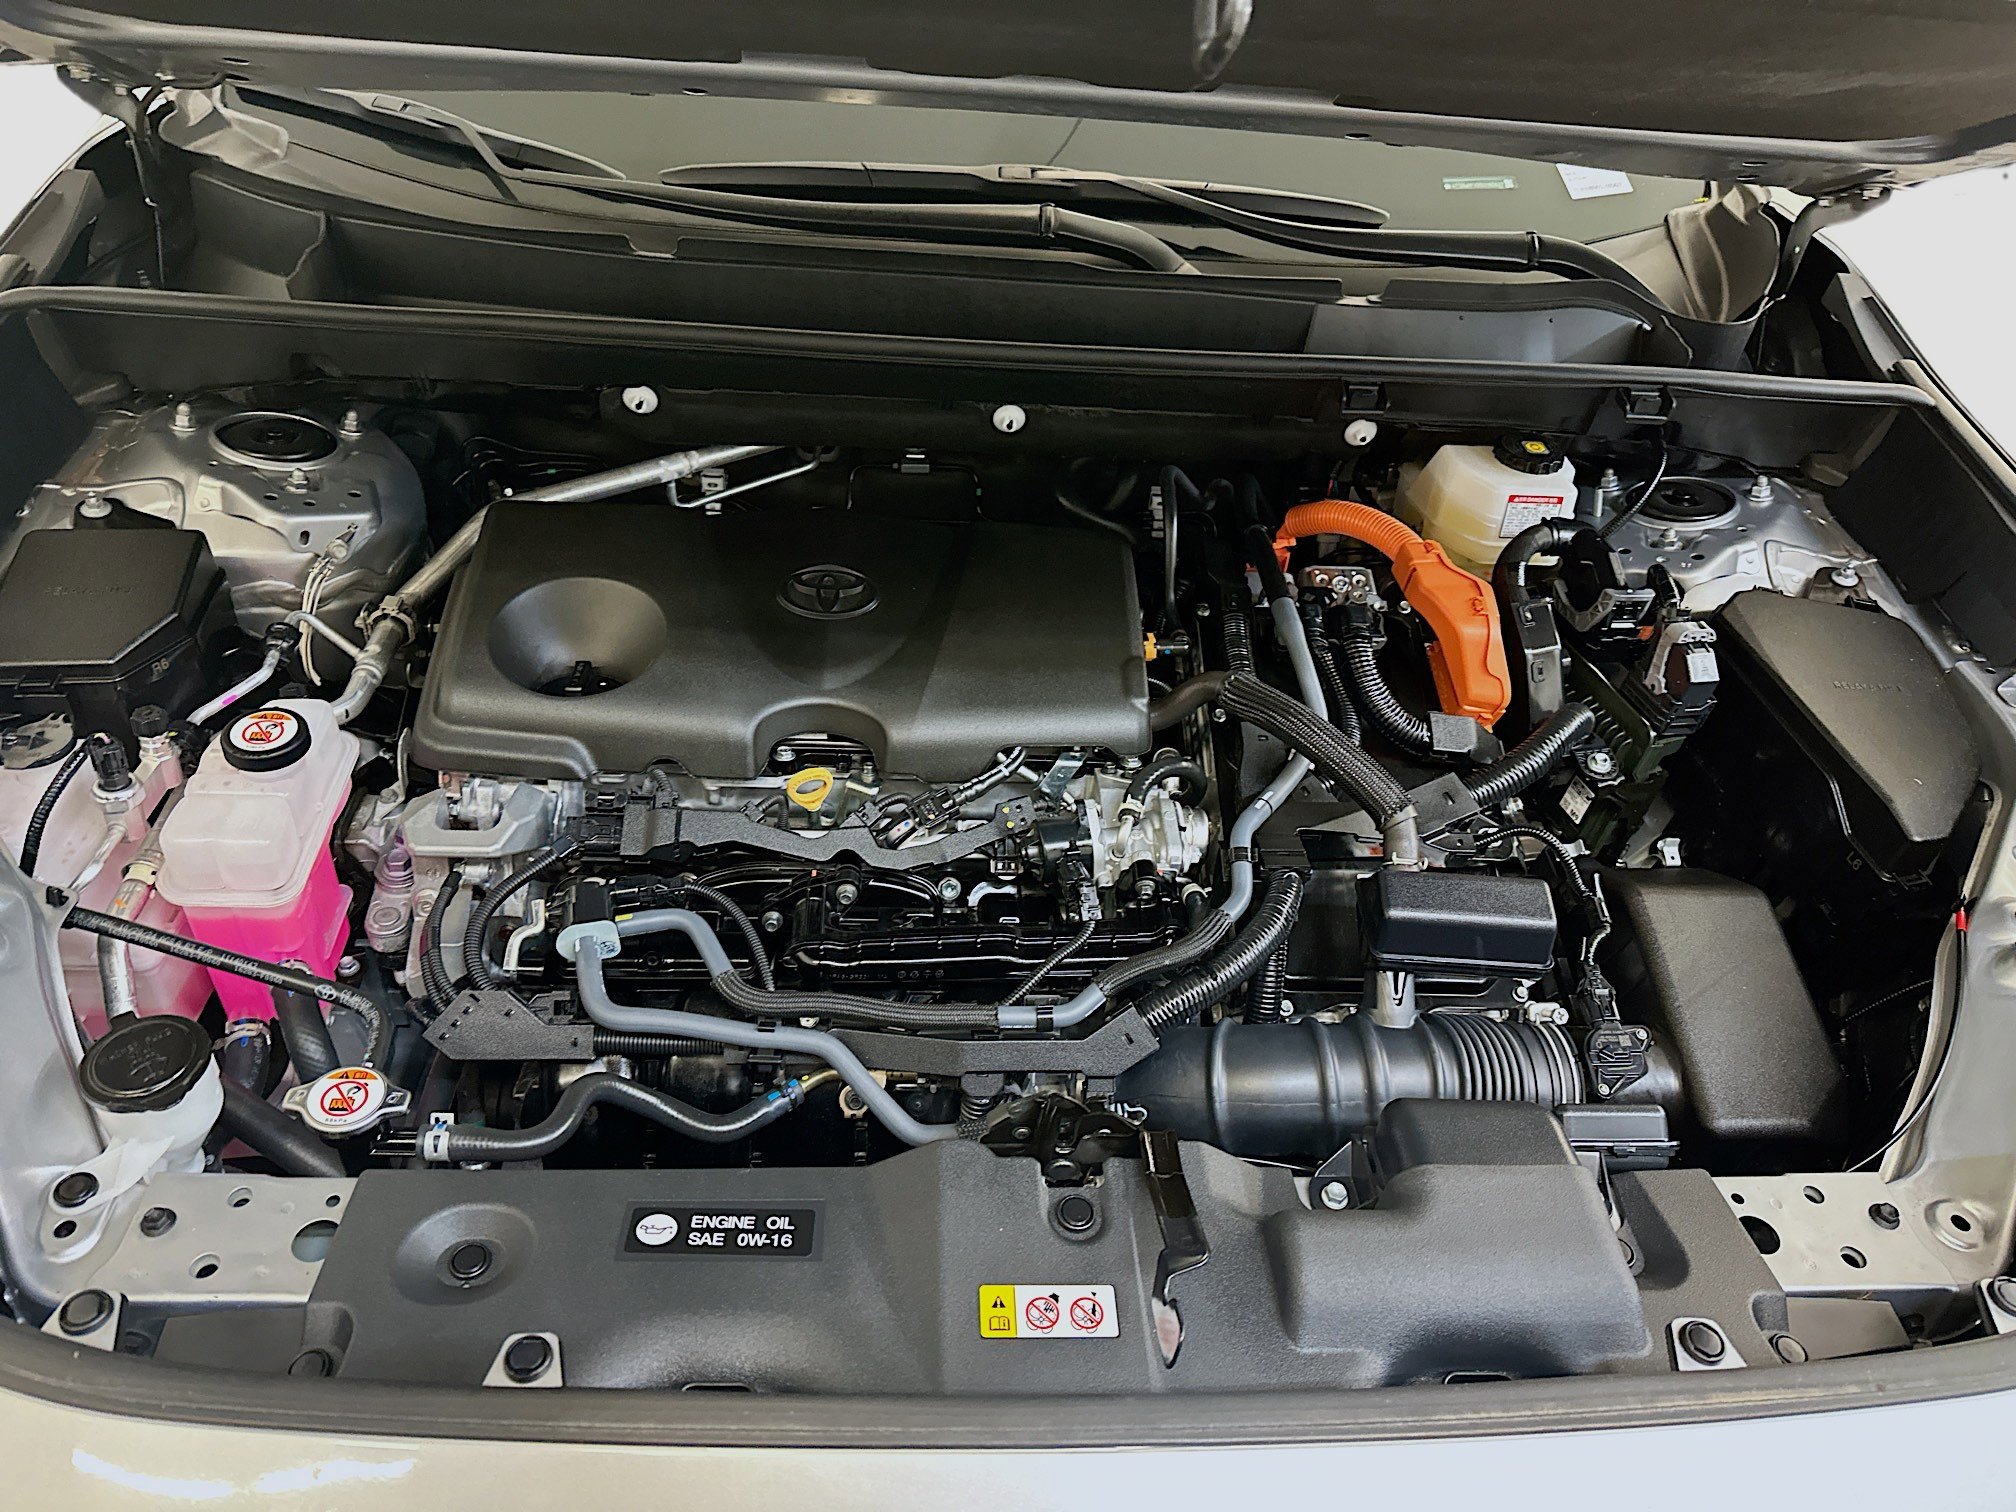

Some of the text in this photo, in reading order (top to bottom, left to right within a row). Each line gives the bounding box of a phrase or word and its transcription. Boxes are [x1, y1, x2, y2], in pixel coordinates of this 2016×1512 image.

[151, 657, 170, 674] R6
[1846, 850, 1862, 871] L6
[690, 1215, 795, 1230] ENGINE OIL
[688, 1232, 793, 1247] SAE 0W-16
